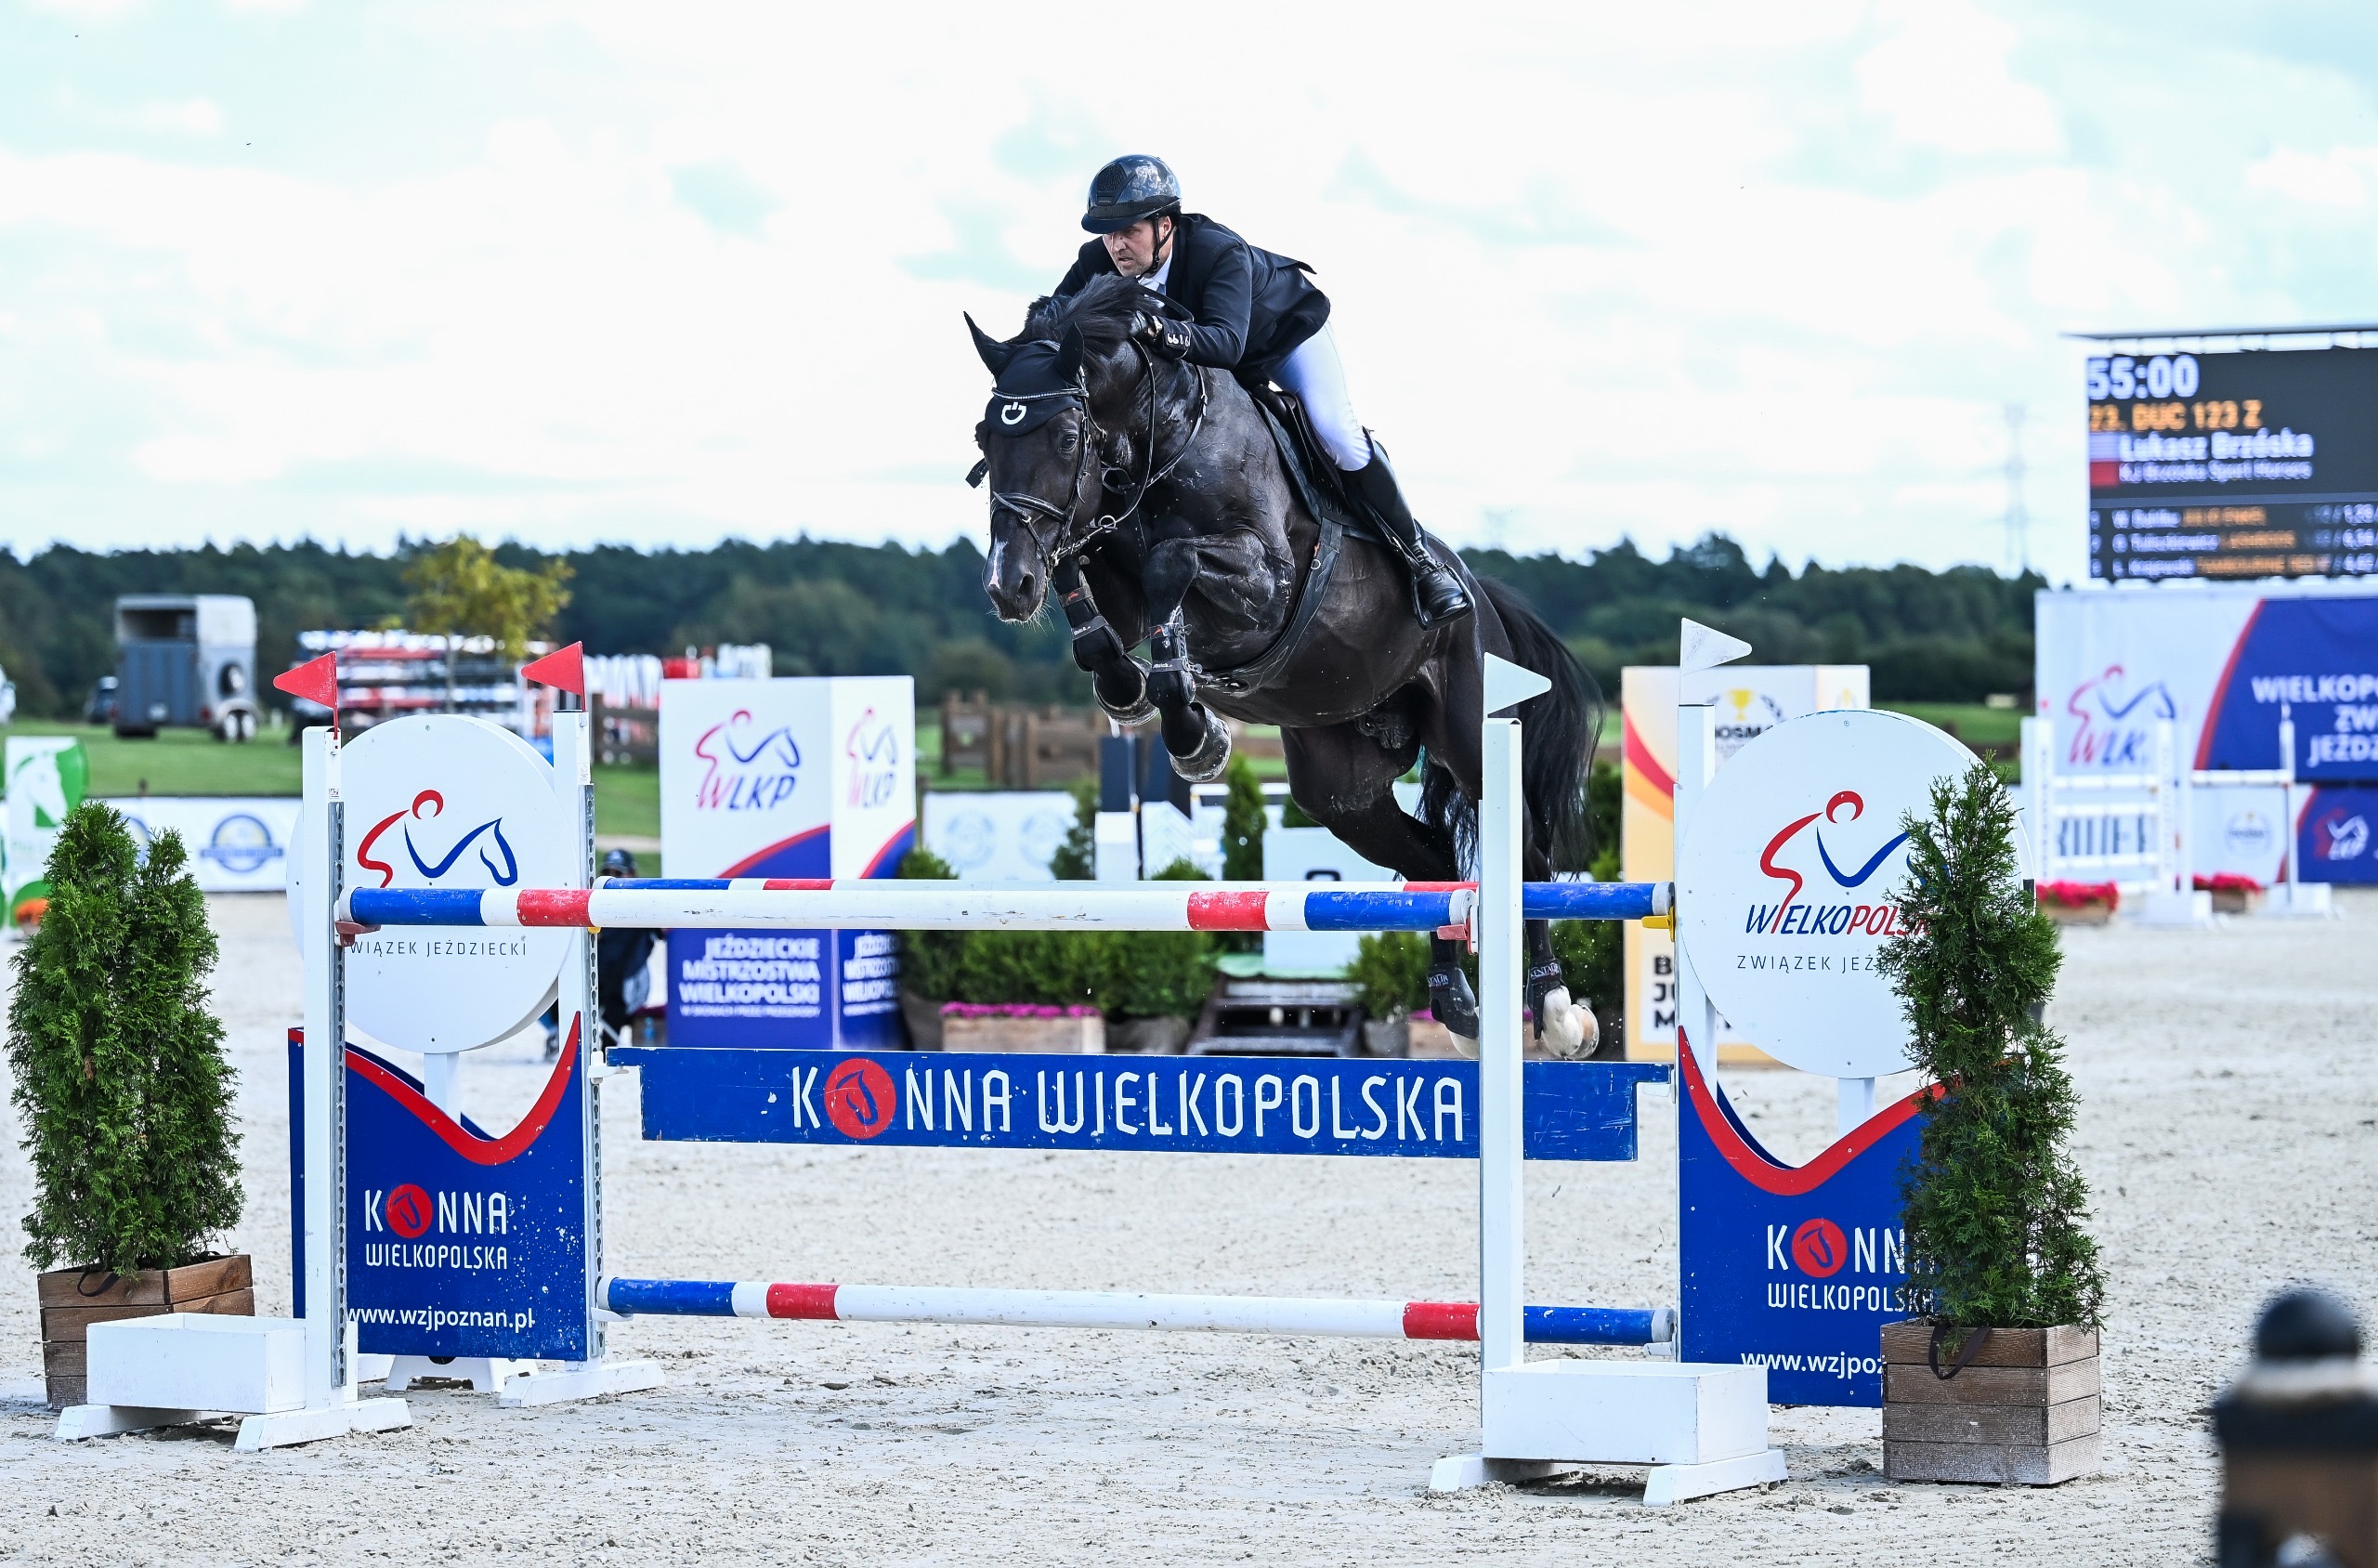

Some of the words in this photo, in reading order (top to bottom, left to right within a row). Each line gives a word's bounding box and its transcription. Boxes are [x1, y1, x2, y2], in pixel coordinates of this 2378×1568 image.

[2088, 354, 2200, 400] 55:00
[2251, 673, 2378, 704] WIELKOP
[2069, 729, 2149, 765] WLK
[699, 774, 796, 810] WLKP
[349, 941, 417, 958] WIĄZEK
[426, 939, 526, 958] JEŹDZIECKI
[682, 960, 821, 982] MISTRZOSTWA
[1737, 955, 1831, 973] ZWIĄZEK
[678, 982, 820, 1004] WIELKOPOLSKI
[1038, 1070, 1464, 1142] WIELKOPOLSKA
[365, 1243, 508, 1270] WIELKOPOLSKA
[346, 1305, 534, 1333] www.wzjpoznan.pl
